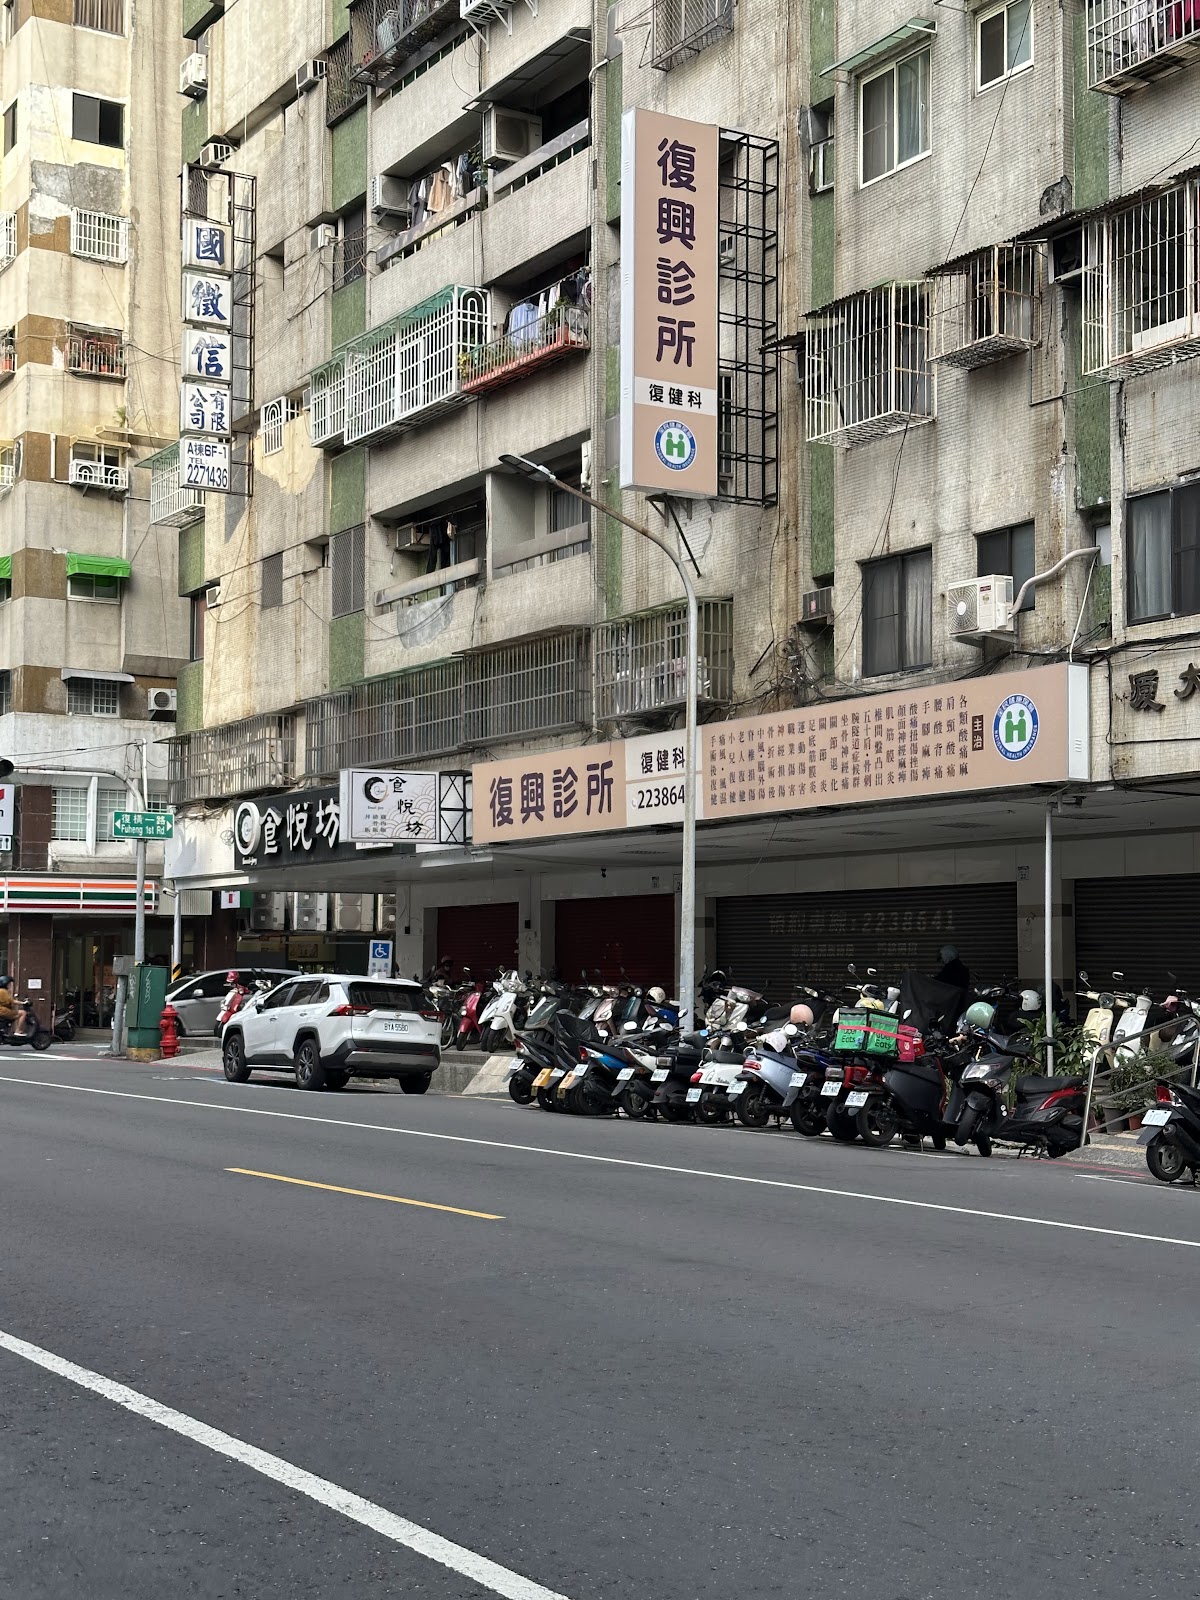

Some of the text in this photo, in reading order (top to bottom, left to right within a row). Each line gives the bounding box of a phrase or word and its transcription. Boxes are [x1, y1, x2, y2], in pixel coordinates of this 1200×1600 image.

[655, 138, 697, 368] 復興診所
[190, 388, 208, 429] 公司
[209, 390, 228, 431] 有限
[649, 383, 702, 409] 復健科
[187, 442, 227, 459] A棟6F-1
[187, 464, 228, 488] 2271436
[641, 746, 685, 774] 復健科
[798, 721, 806, 795] 運動傷害
[808, 719, 816, 793] 足底筋膜炎
[819, 717, 827, 792] 關節炎
[830, 715, 838, 792] 關節退化
[841, 714, 849, 790] 坐骨神經痛
[852, 712, 860, 788] 腕隧道症候群
[875, 708, 883, 786] 椎間盤凸出
[886, 706, 894, 785] 肌筋膜炎
[909, 703, 918, 782] 酸痛扭傷挫傷
[933, 697, 943, 780] 腰酸背痛
[946, 696, 956, 778] 肩頸酸痛
[973, 718, 983, 749] 主治
[1006, 751, 1023, 759] HEALTH
[489, 760, 614, 828] 復興診所
[637, 784, 686, 809] 223864
[738, 731, 746, 802] 老人復健
[121, 814, 165, 825] 復橫一路
[121, 823, 143, 836] Fuheng
[145, 825, 154, 834] 1st
[261, 797, 340, 856] 食悅坊
[388, 776, 424, 836] 食悅坊
[841, 1035, 856, 1043] Eats
[874, 1039, 892, 1049] Eats
